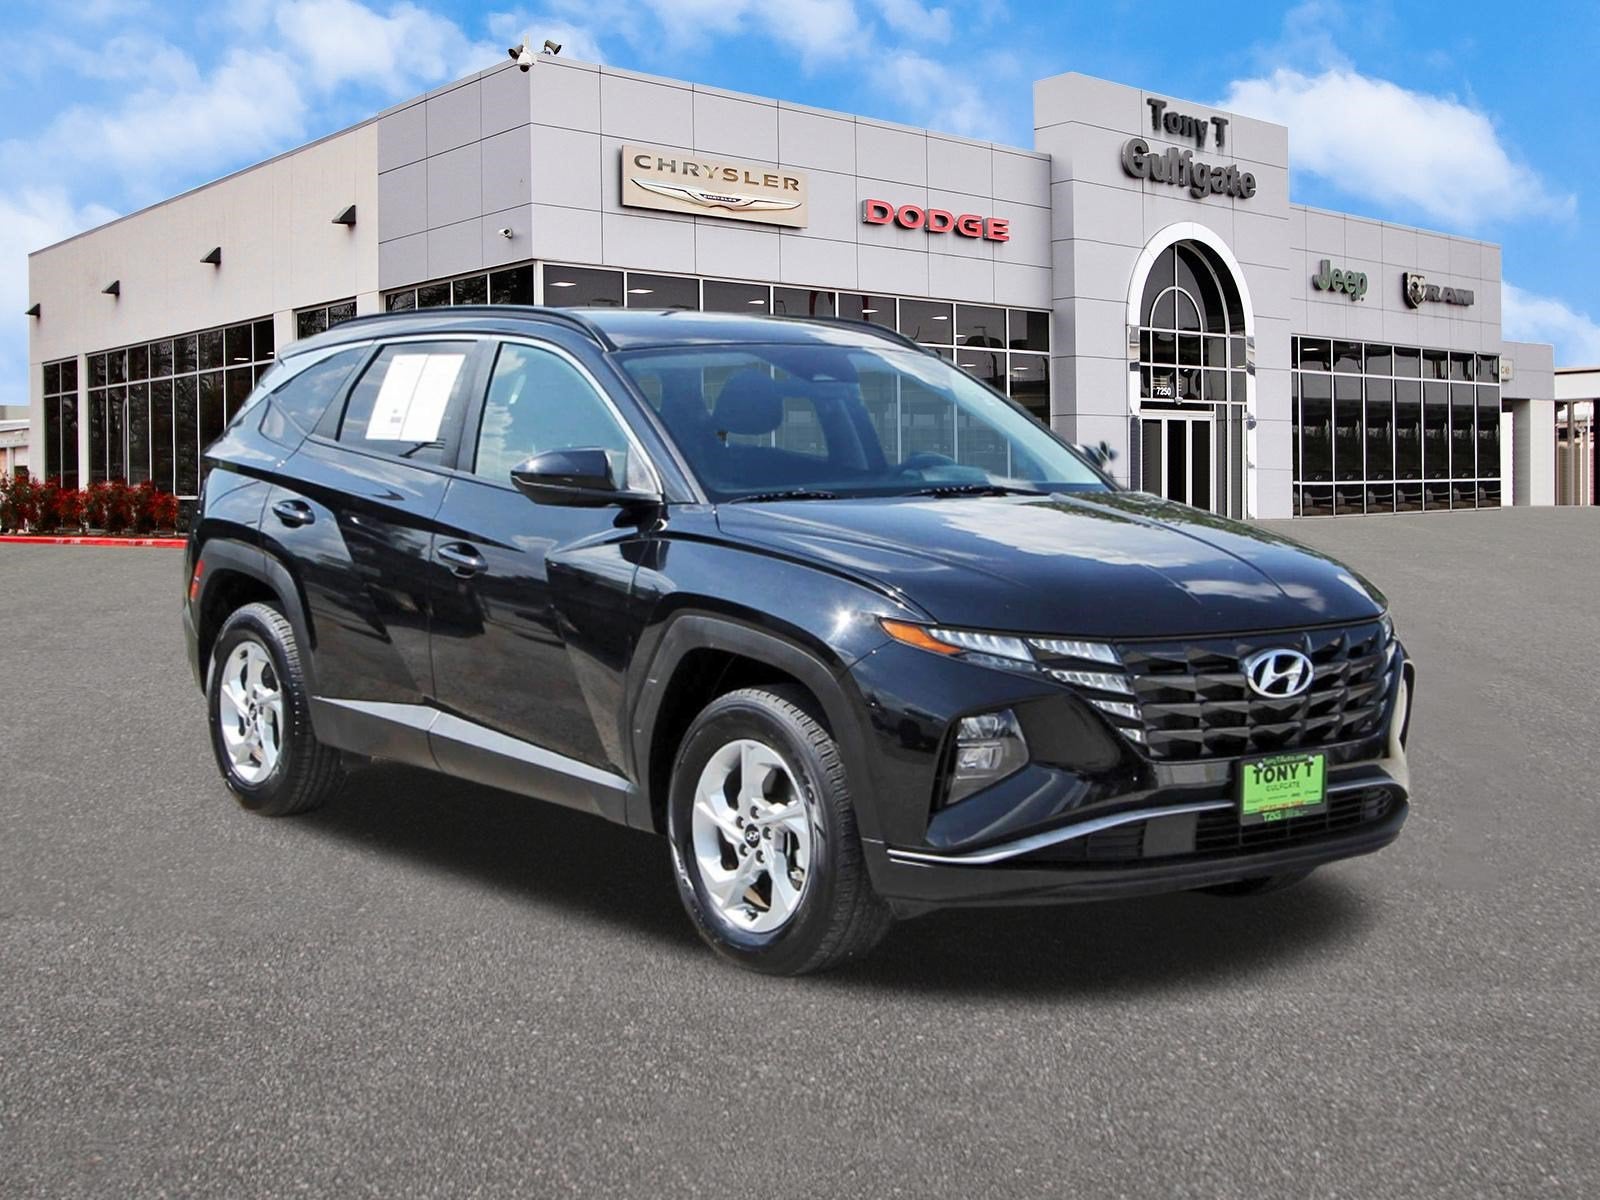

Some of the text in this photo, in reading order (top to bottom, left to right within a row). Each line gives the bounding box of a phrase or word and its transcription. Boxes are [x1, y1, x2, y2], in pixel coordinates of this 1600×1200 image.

[1147, 98, 1229, 148] Tony T
[632, 153, 801, 192] CHRYSLER
[1121, 138, 1257, 199] Gulfgate
[862, 198, 1011, 242] DODGE
[1312, 259, 1368, 302] Jeep
[1424, 284, 1475, 306] RAM
[1253, 761, 1314, 785] TONY T
